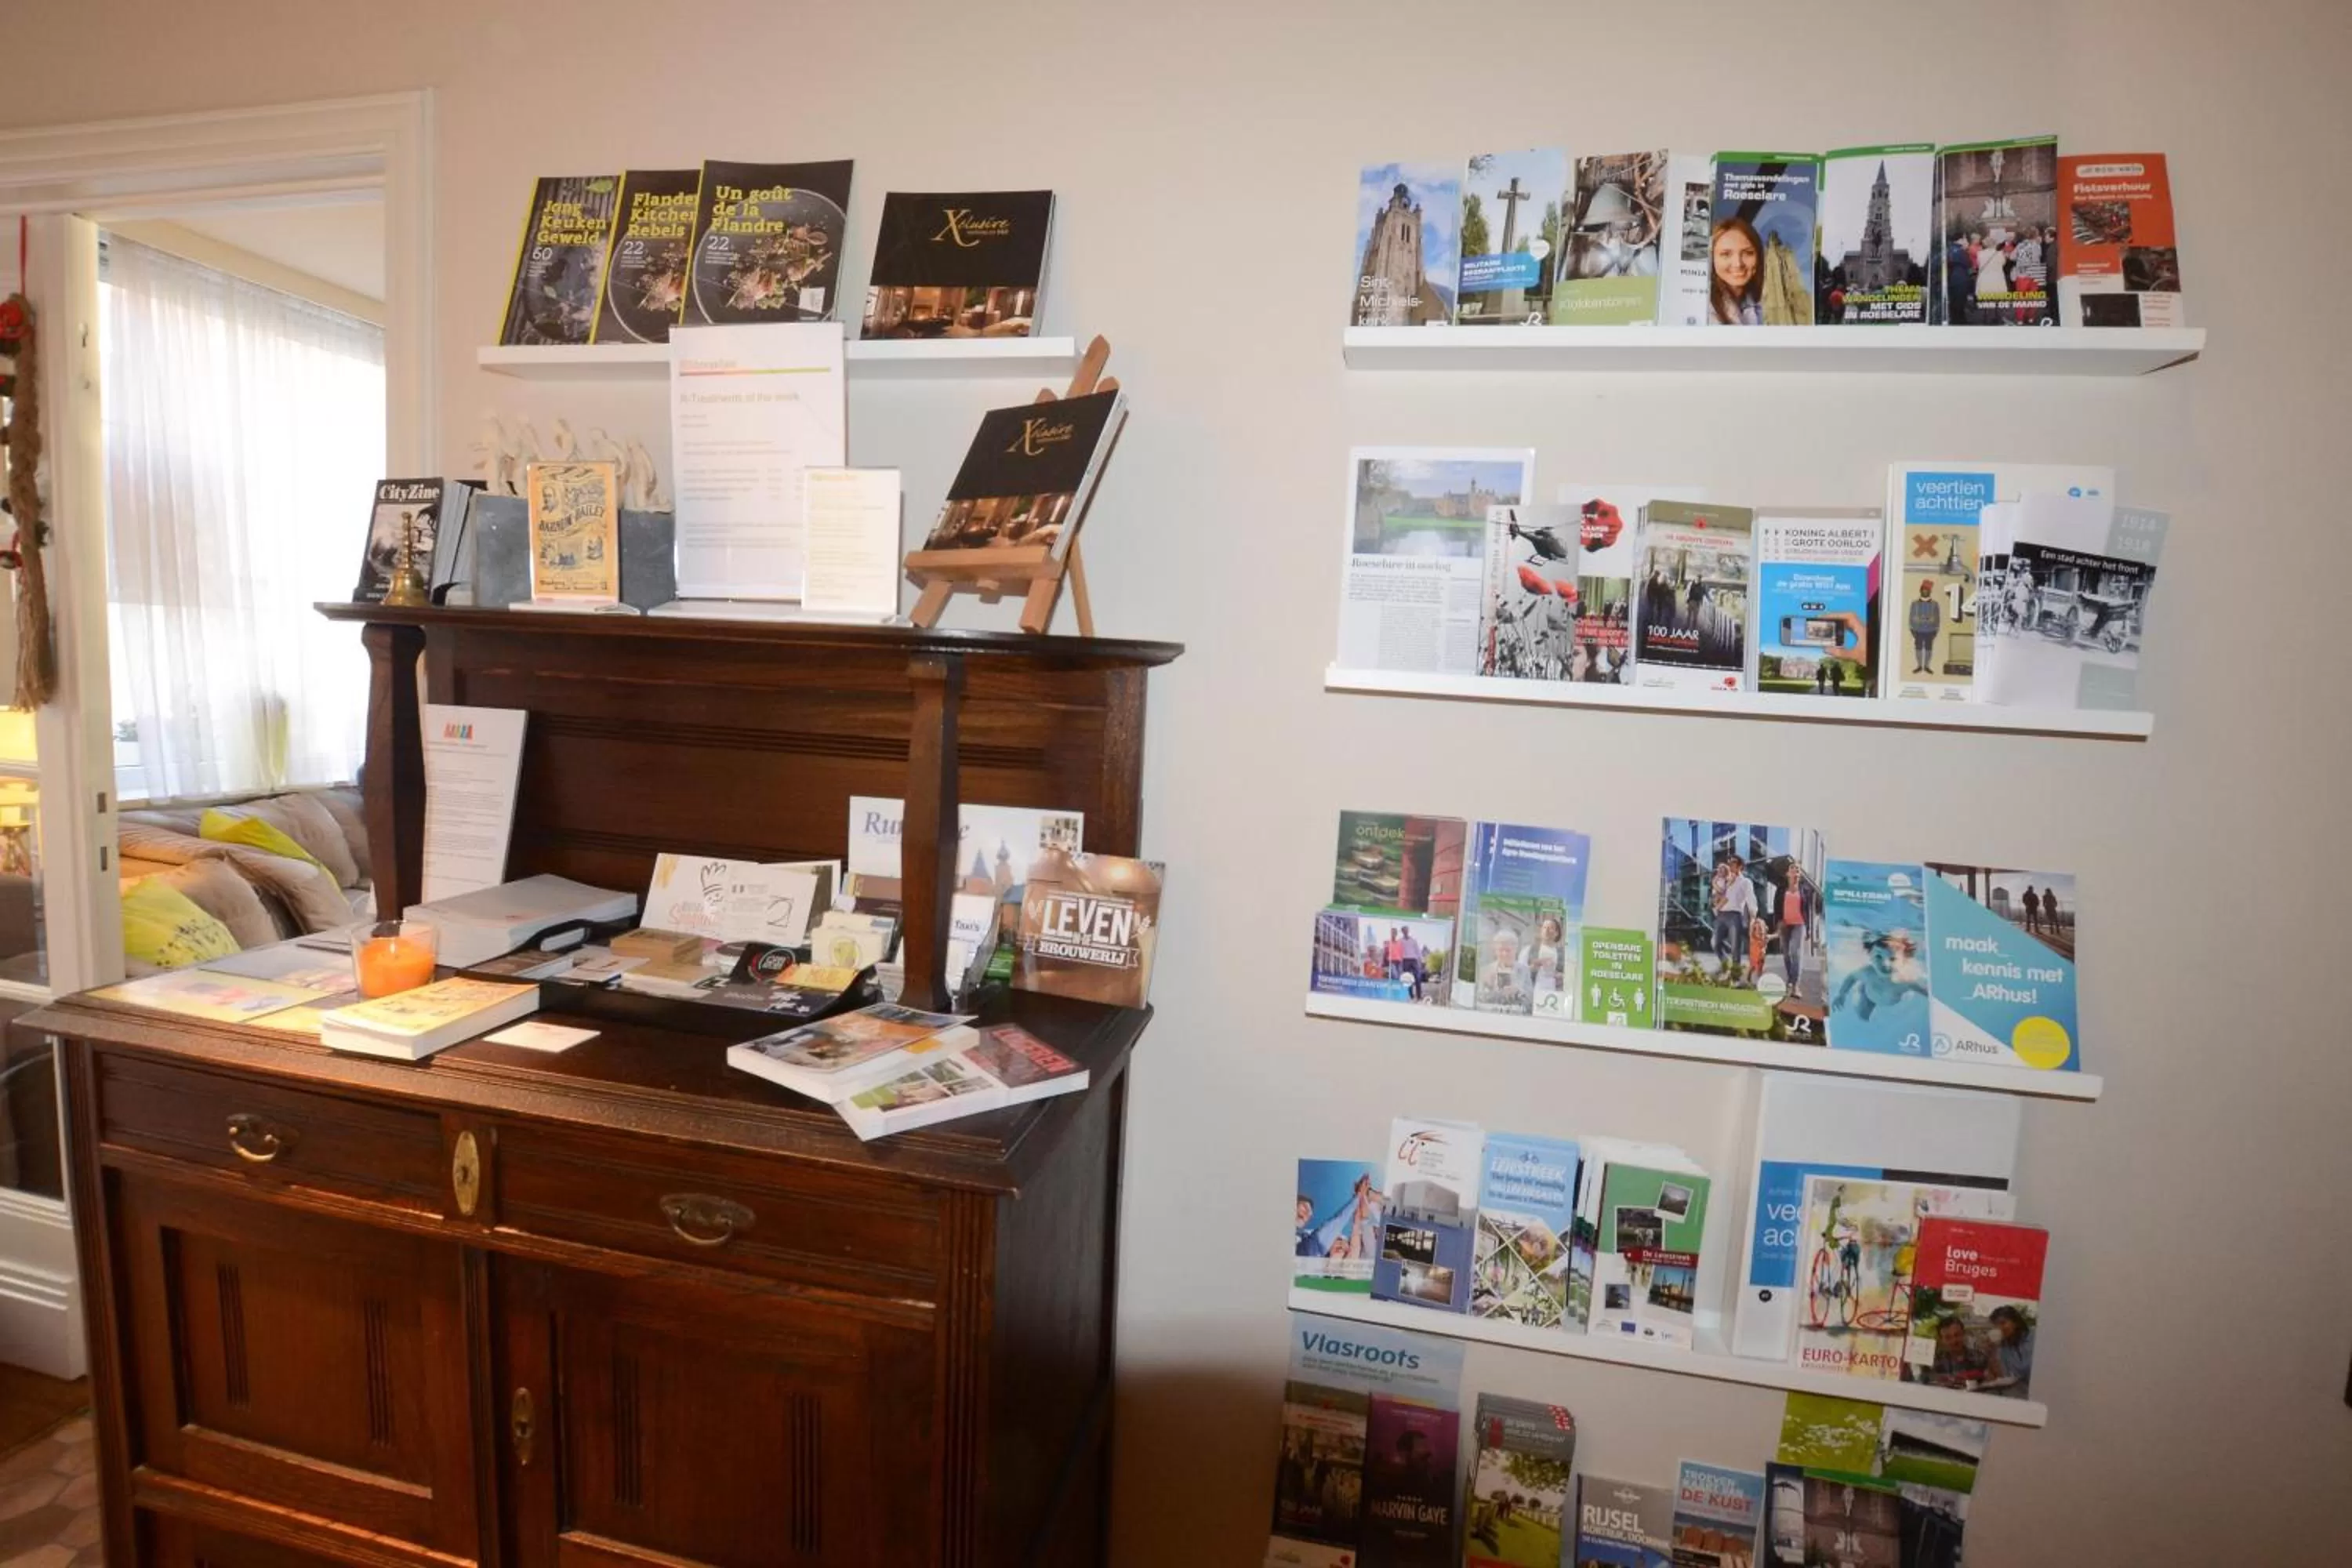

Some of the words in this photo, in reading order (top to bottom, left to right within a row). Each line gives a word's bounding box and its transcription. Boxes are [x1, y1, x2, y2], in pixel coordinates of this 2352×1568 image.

[716, 186, 742, 200] Un
[750, 185, 793, 203] goût
[1723, 189, 1787, 201] Roeselare
[543, 200, 581, 216] Jong
[713, 201, 735, 216] de
[743, 203, 759, 216] la
[541, 216, 606, 230] Keuken
[627, 223, 684, 237] Rebels
[711, 217, 784, 233] Flandre
[536, 230, 599, 245] Geweld
[707, 236, 729, 250] 22
[532, 247, 552, 260] 60
[623, 241, 644, 255] 22
[1860, 310, 1920, 319] ROESELARE
[379, 483, 441, 502] CityZine
[1915, 479, 1985, 495] veertien
[1914, 495, 1984, 510] achttien
[1785, 528, 1826, 538] KONING
[1827, 528, 1869, 539] ALBERT
[1791, 539, 1824, 547] GROTE
[1828, 539, 1871, 548] OORLOG
[2040, 550, 2056, 559] Een
[2056, 552, 2075, 563] stad
[2076, 556, 2102, 568] achter
[2103, 560, 2116, 571] het
[2117, 562, 2139, 574] front
[1647, 624, 1668, 637] 100
[1670, 628, 1700, 641] JAAR
[1042, 898, 1133, 946] LEVEN
[1039, 940, 1127, 964] BROUWERIJ
[1592, 941, 1642, 953] OPENBARE
[1592, 950, 1642, 962] TOILETTEN
[1962, 957, 2022, 979] kennis
[2027, 967, 2063, 983] met
[1973, 982, 2038, 1004] ARhus!
[1955, 1040, 1999, 1054] ARhus
[1947, 1245, 1978, 1261] Love
[1945, 1258, 1998, 1278] Bruges
[1301, 1330, 1421, 1370] Vlasroots
[1802, 1348, 1899, 1369] EURO-KARTO
[1680, 1488, 1704, 1503] DE
[1708, 1491, 1754, 1512] KUST
[1370, 1499, 1416, 1520] MARVIN
[1417, 1504, 1449, 1526] GAYE
[1582, 1504, 1644, 1534] RIJSEL
